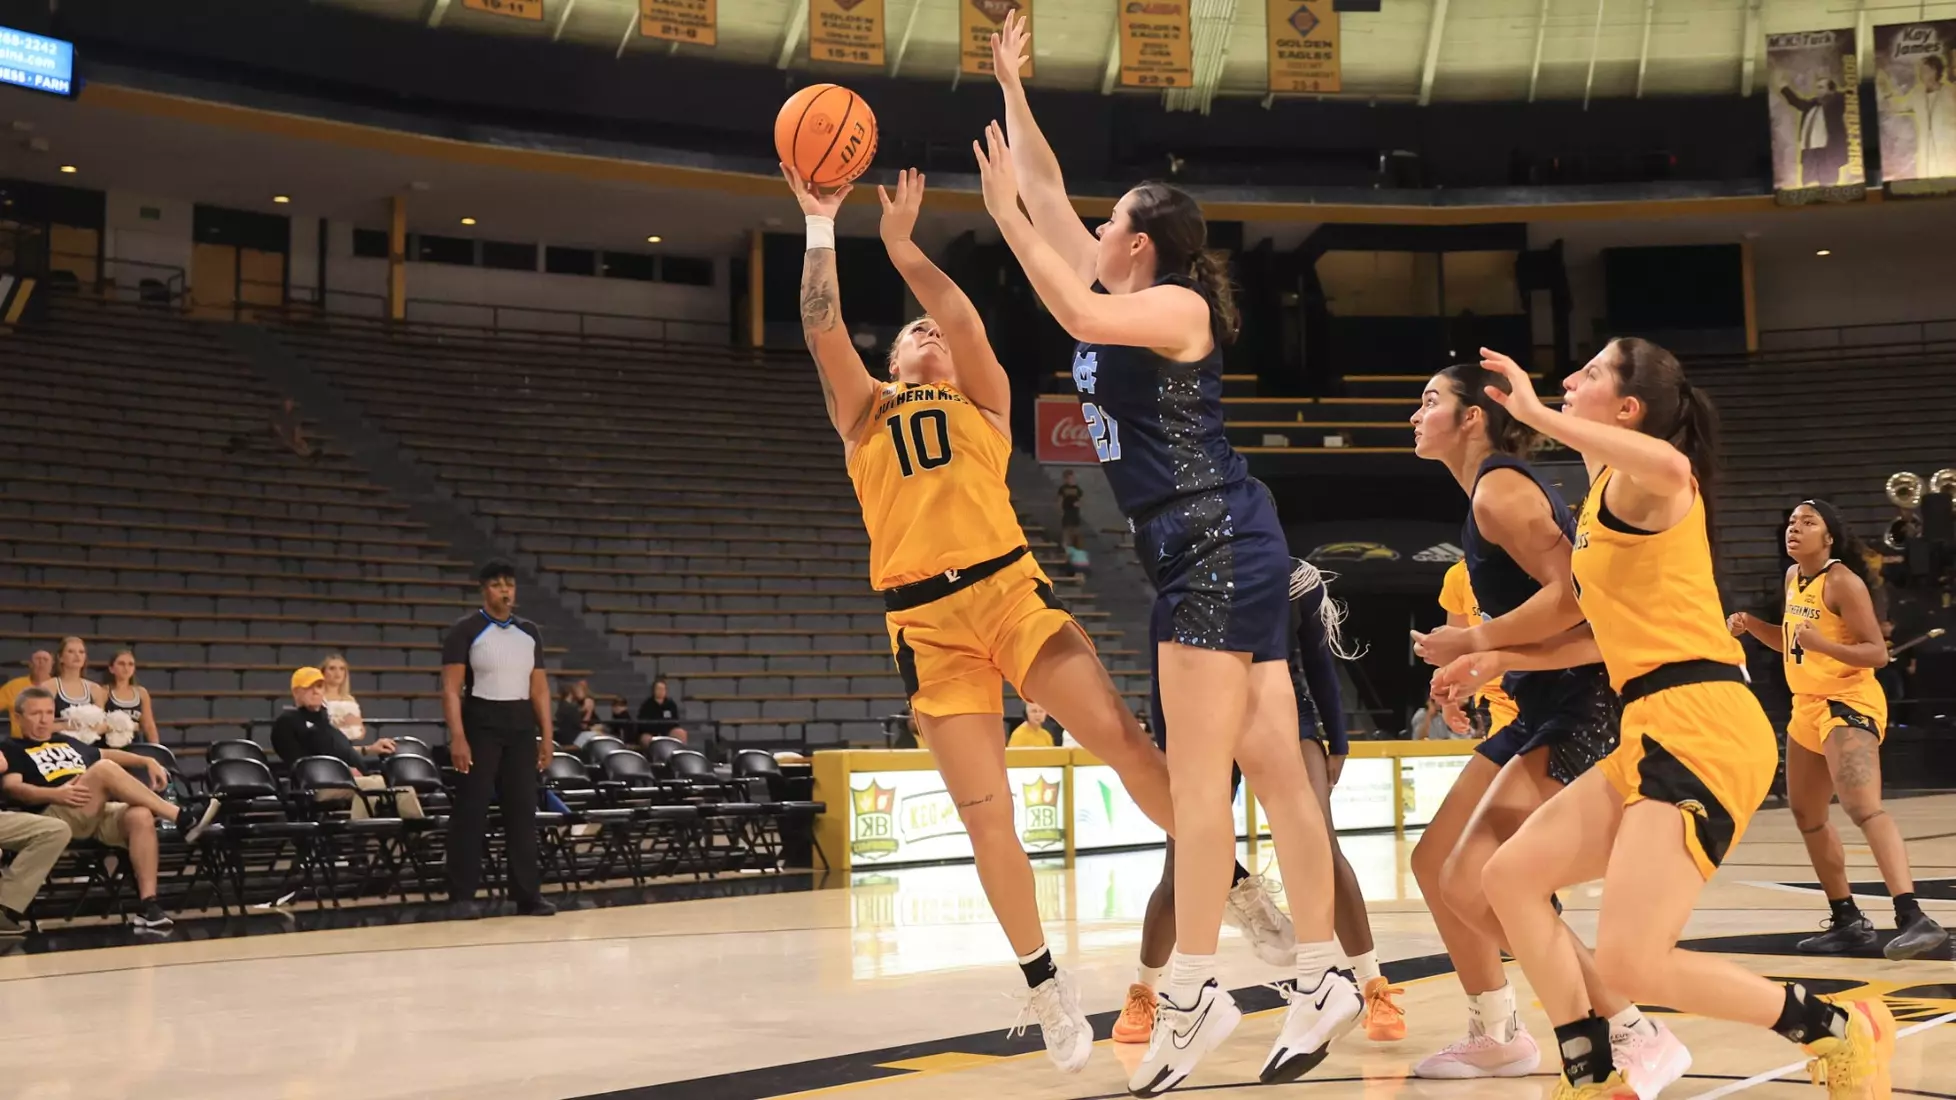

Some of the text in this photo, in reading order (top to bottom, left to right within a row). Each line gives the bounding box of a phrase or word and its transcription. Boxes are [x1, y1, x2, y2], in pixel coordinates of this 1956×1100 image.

[1276, 38, 1333, 49] GOLDEN
[1902, 27, 1932, 44] Kay
[1278, 50, 1333, 61] EAGLES
[1894, 41, 1942, 59] James
[1081, 402, 1122, 463] 21
[886, 408, 953, 478] 10
